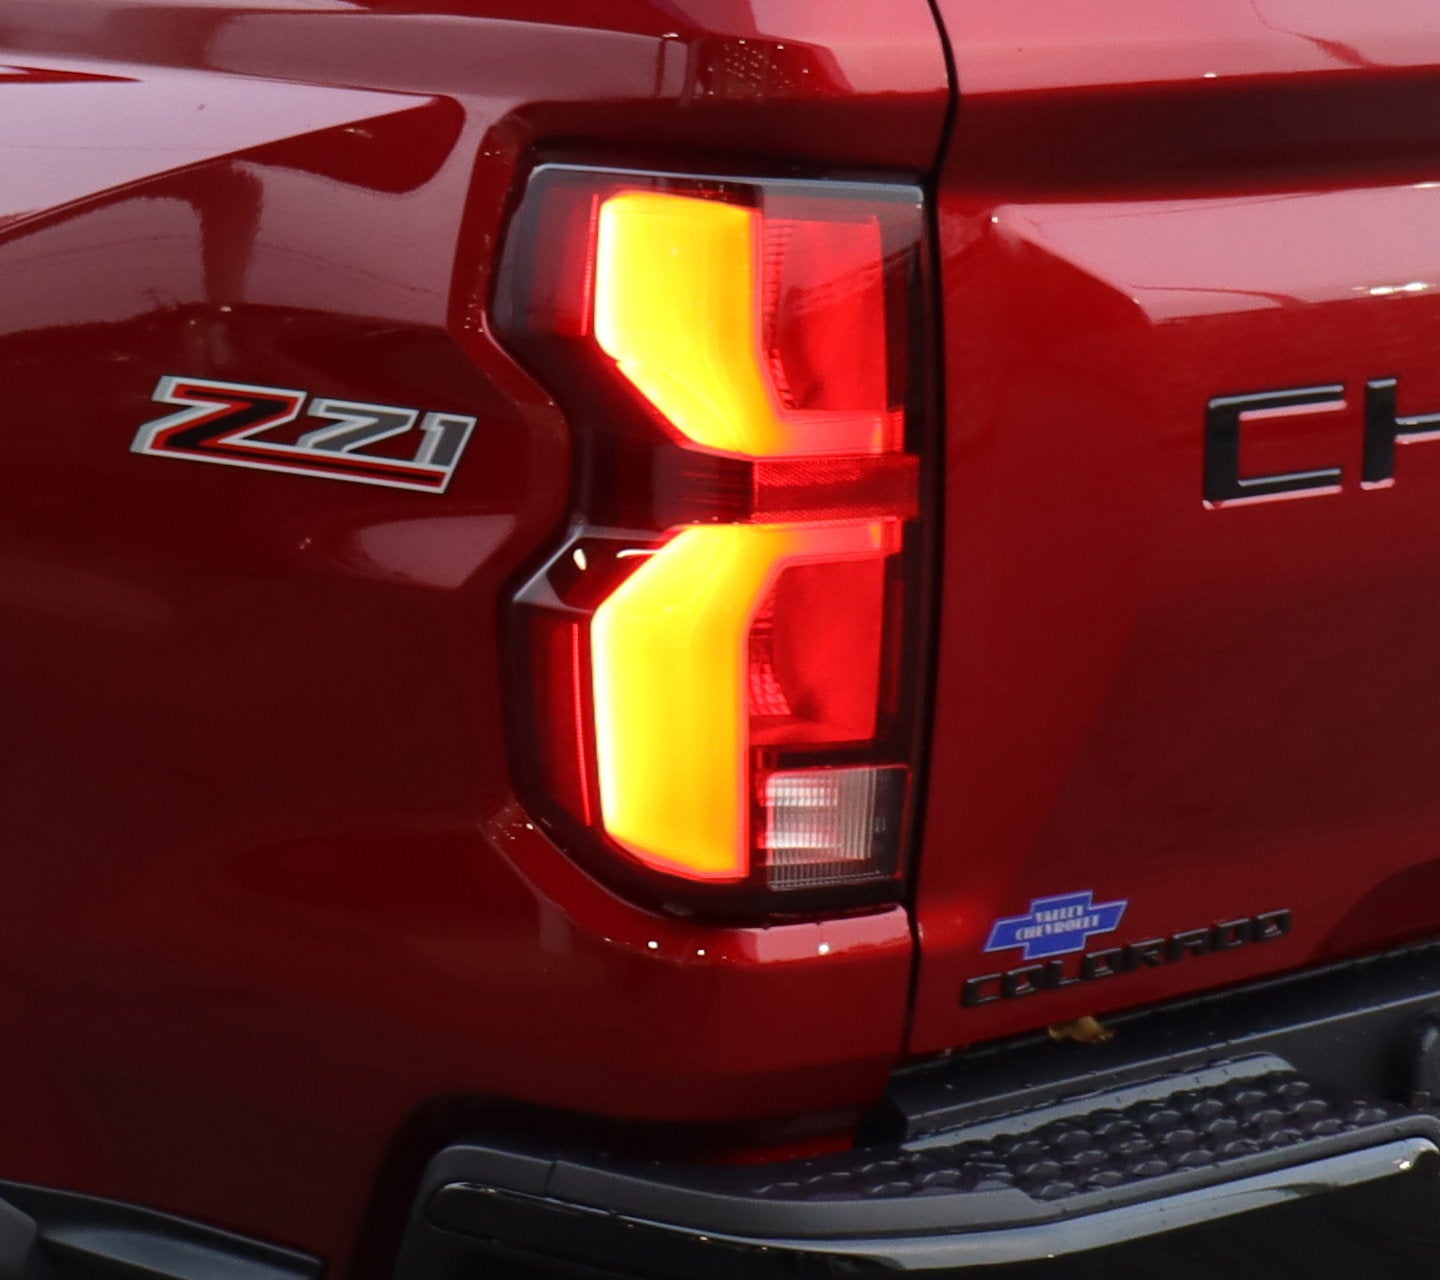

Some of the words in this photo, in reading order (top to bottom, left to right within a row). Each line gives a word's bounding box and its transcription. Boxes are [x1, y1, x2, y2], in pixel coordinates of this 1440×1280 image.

[130, 375, 477, 494] Z71
[1015, 914, 1100, 941] CHEVROLET
[1034, 904, 1084, 923] VALLEY
[961, 909, 1292, 1008] COLORADO
